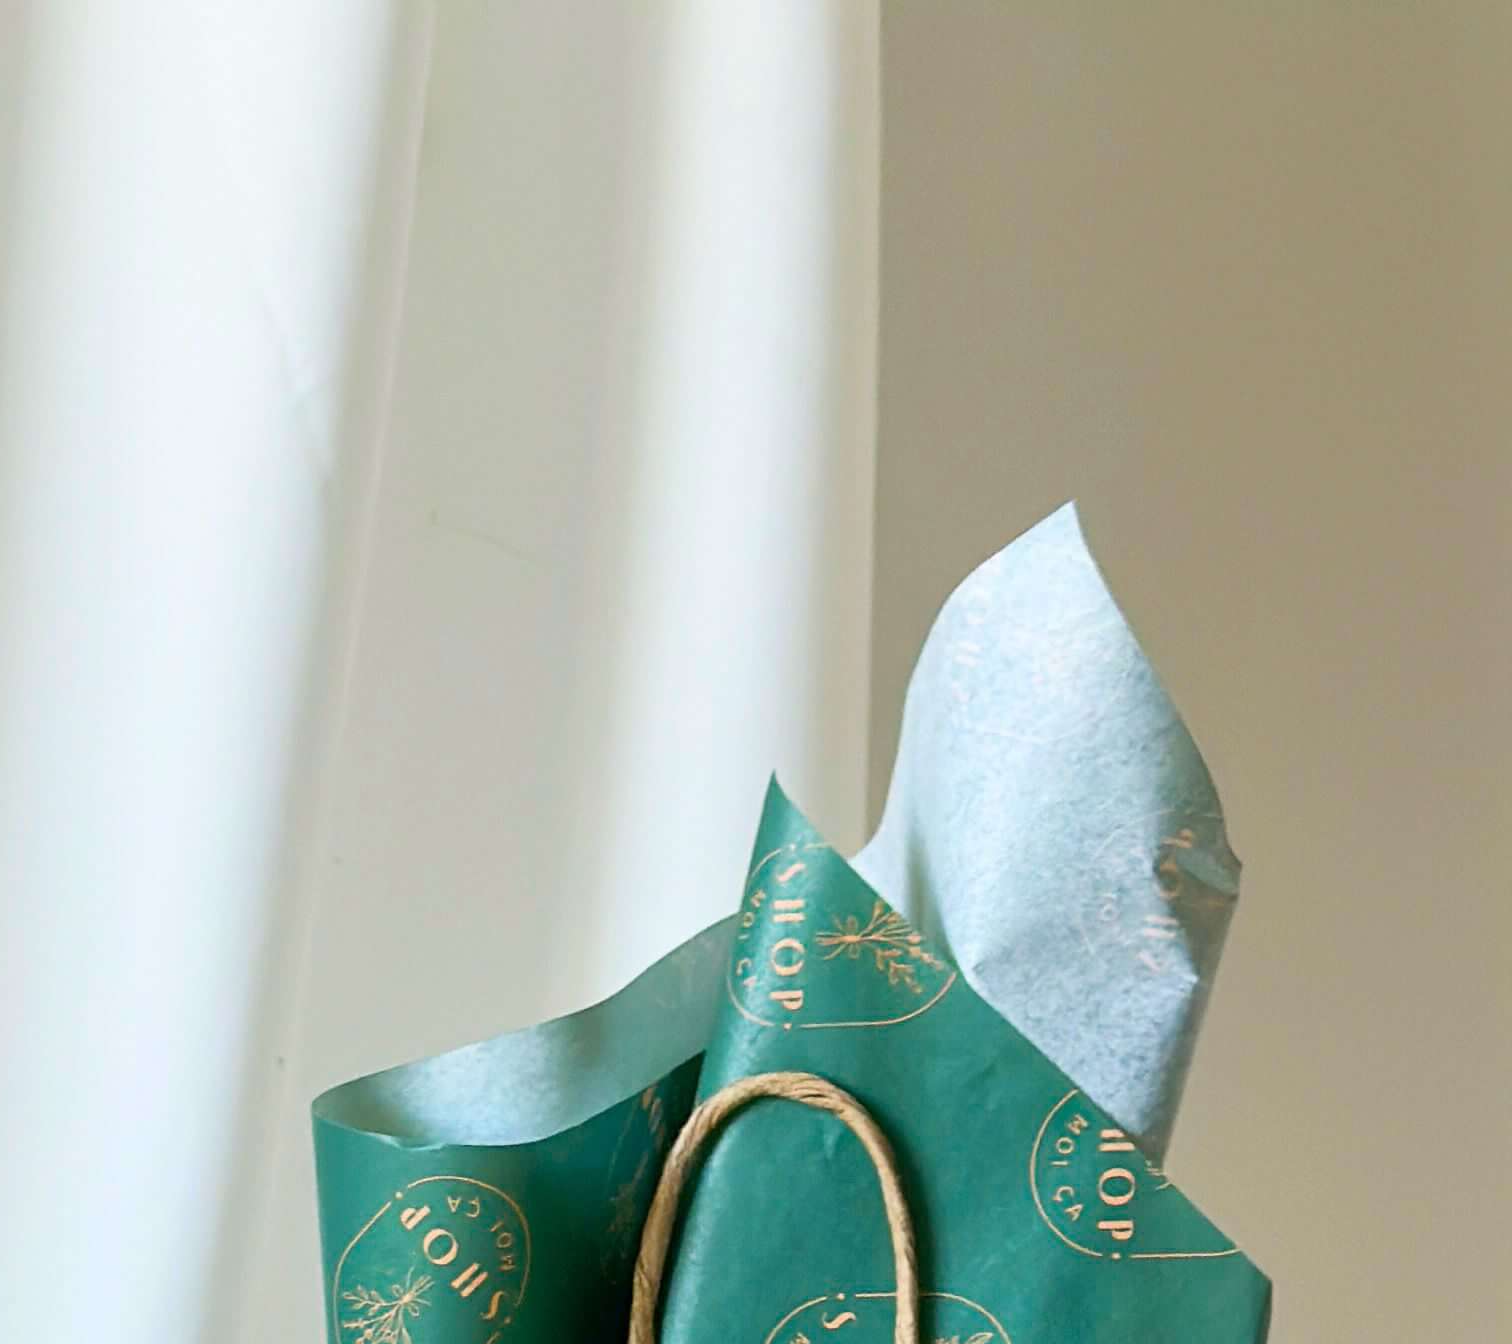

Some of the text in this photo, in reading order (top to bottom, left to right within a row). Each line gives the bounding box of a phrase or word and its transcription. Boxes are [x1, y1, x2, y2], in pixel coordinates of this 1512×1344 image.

[769, 863, 806, 1010] SHOP
[1051, 1114, 1088, 1166] MOI
[1097, 1129, 1136, 1240] HOP
[400, 1204, 506, 1320] SHOP
